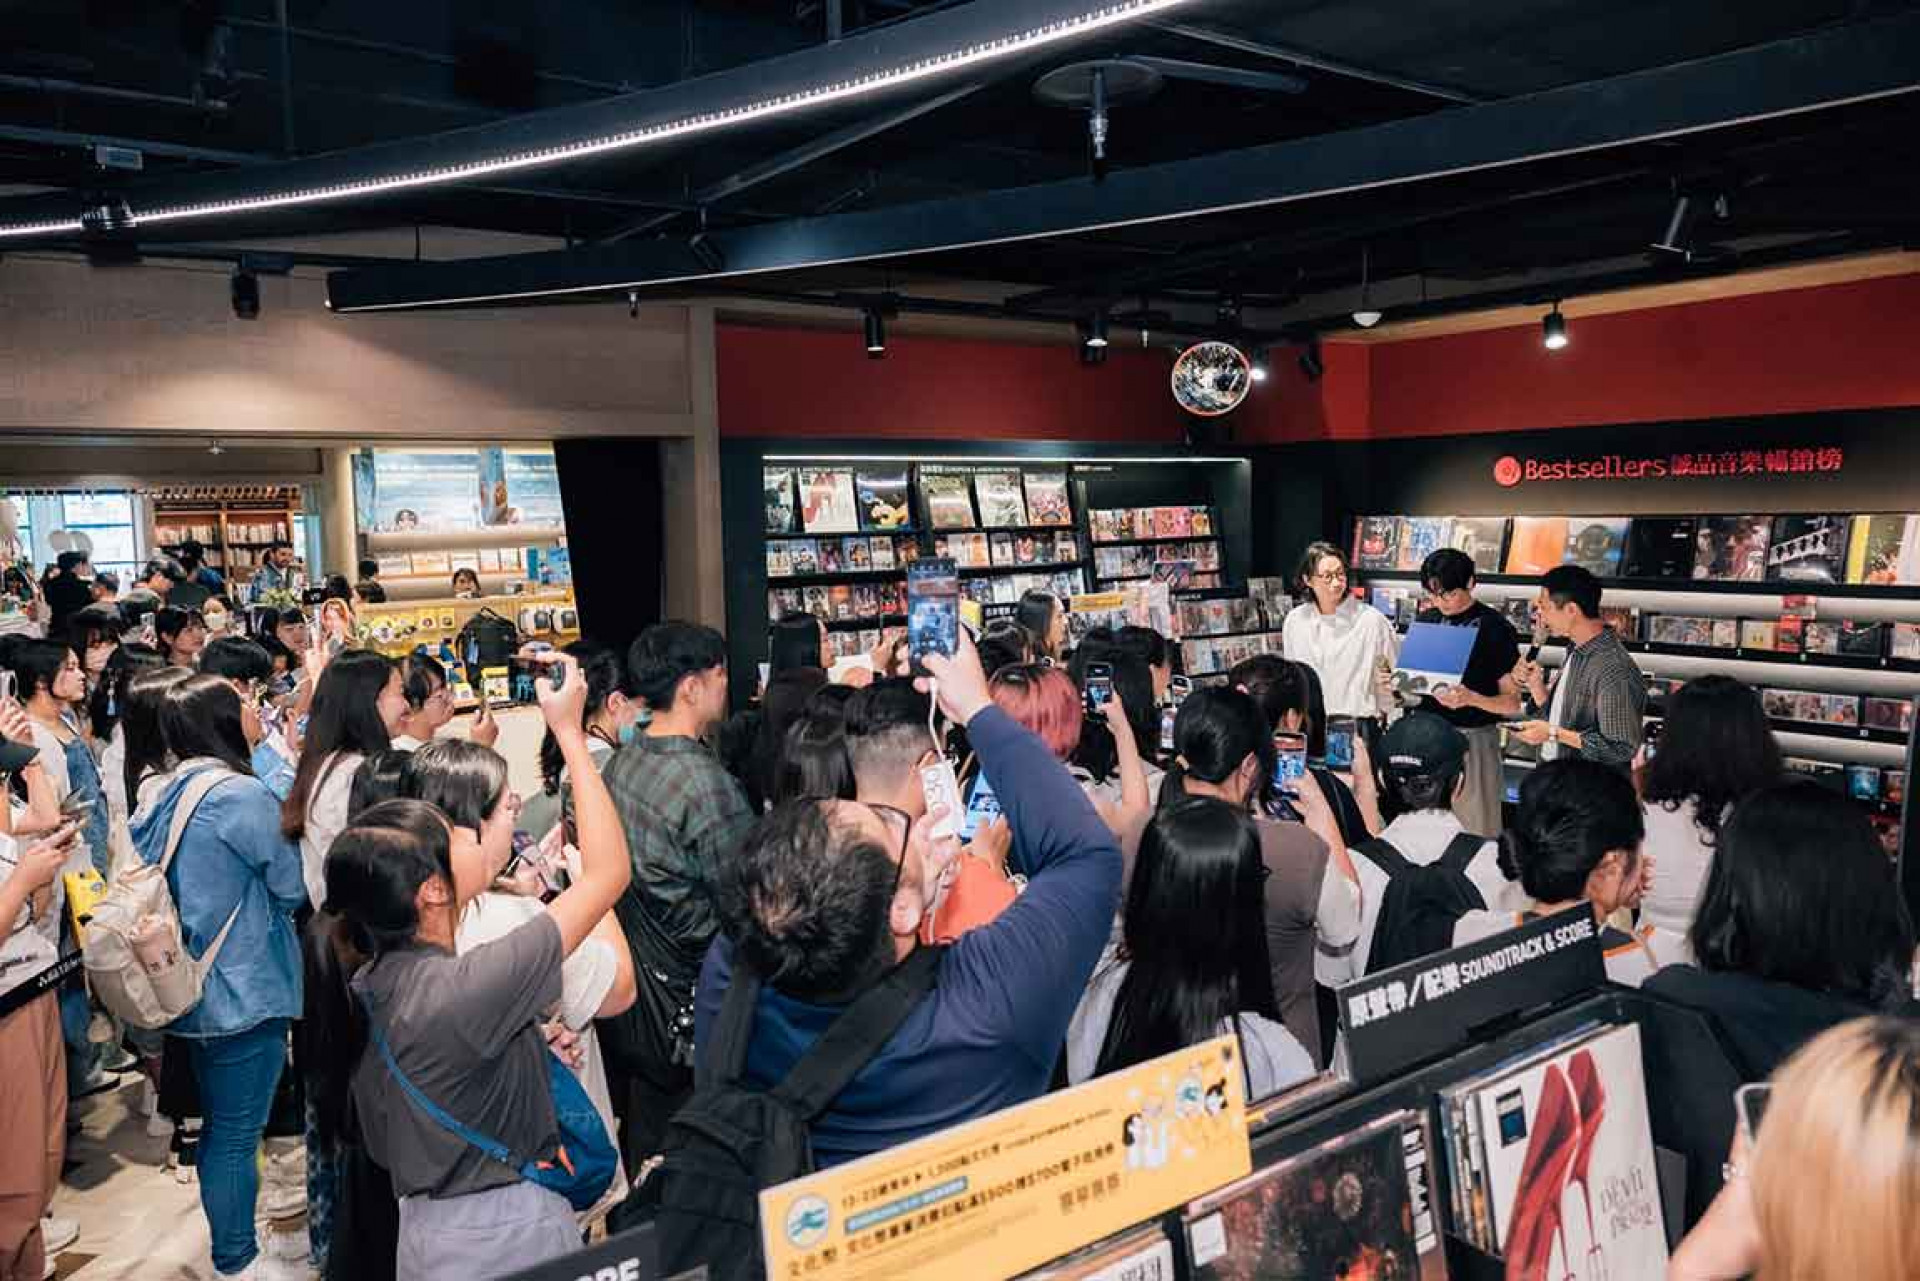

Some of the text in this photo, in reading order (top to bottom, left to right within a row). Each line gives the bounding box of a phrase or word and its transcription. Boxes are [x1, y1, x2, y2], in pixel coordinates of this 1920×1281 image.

[1525, 455, 1668, 482] Bestsellers
[1461, 936, 1546, 985] SOUNDTRACK
[1544, 934, 1556, 953] &
[1555, 917, 1595, 948] SCORE
